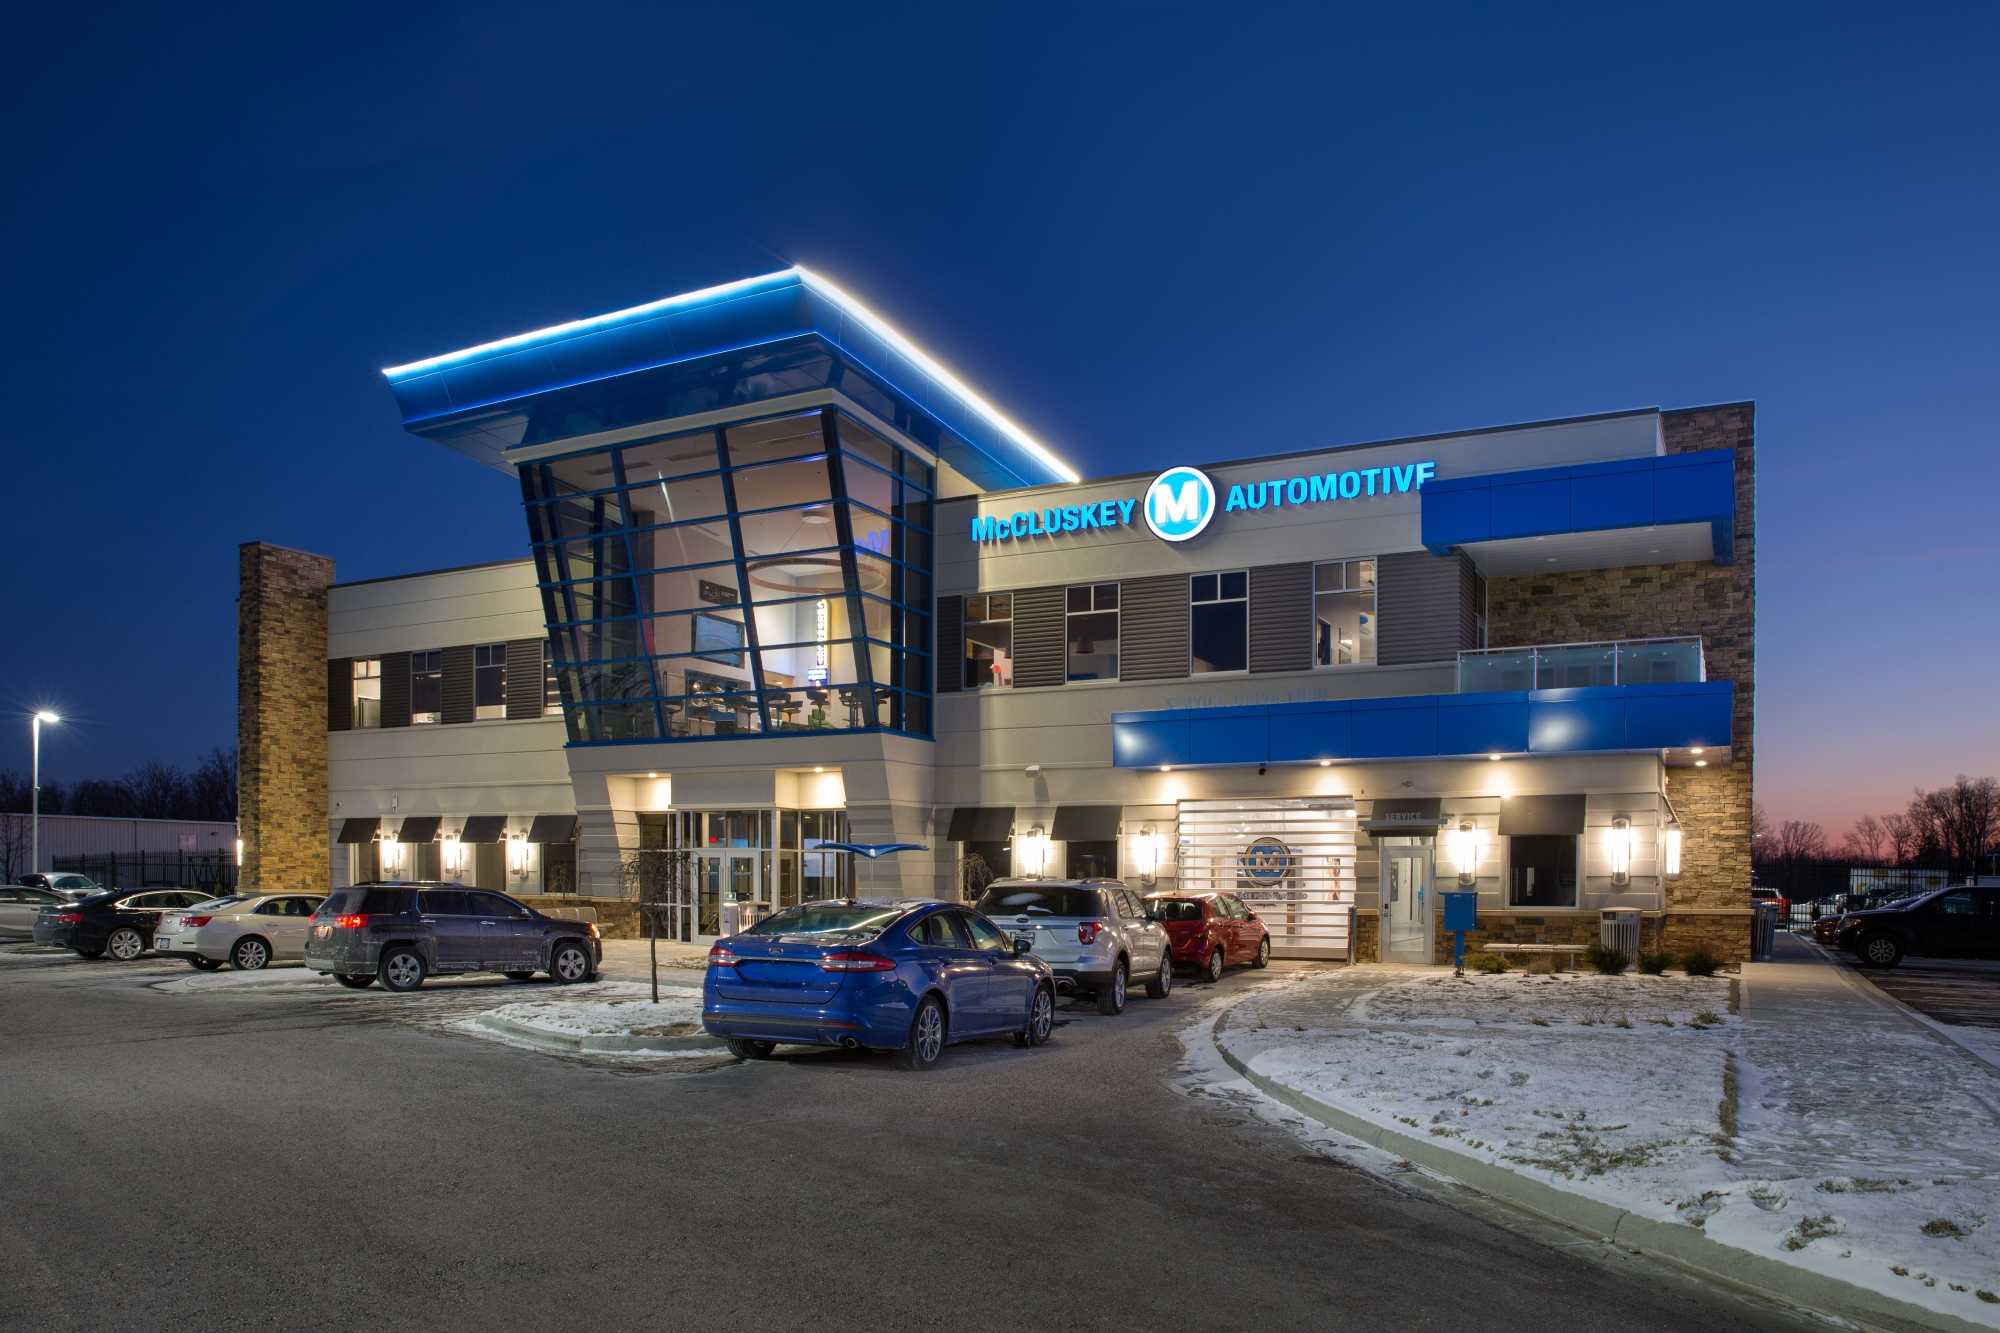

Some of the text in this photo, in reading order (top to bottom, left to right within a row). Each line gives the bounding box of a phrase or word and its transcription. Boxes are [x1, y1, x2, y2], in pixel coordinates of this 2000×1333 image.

[971, 461, 1435, 542] McCLUSKEY M AUTOMOTIVE
[1384, 812, 1423, 822] SERVICE
